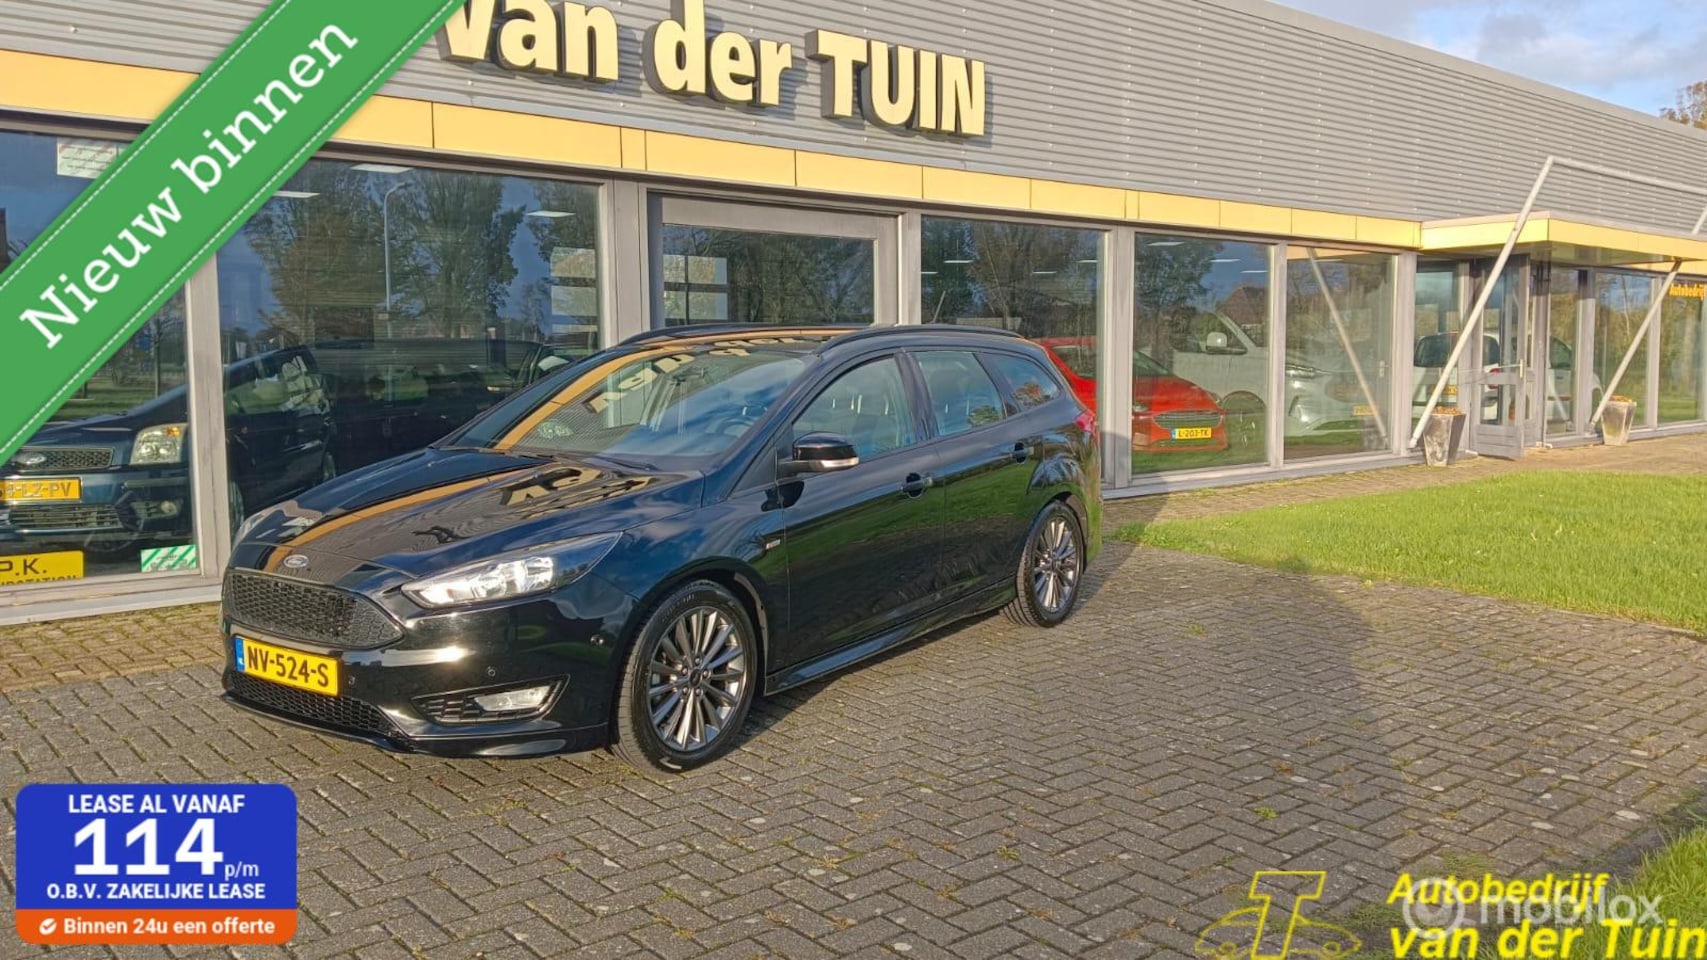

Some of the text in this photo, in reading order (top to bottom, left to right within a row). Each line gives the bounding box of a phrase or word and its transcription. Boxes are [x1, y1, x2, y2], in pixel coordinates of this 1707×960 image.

[652, 0, 793, 105] der
[816, 29, 985, 136] TUIN
[248, 646, 329, 688] NV-524-S
